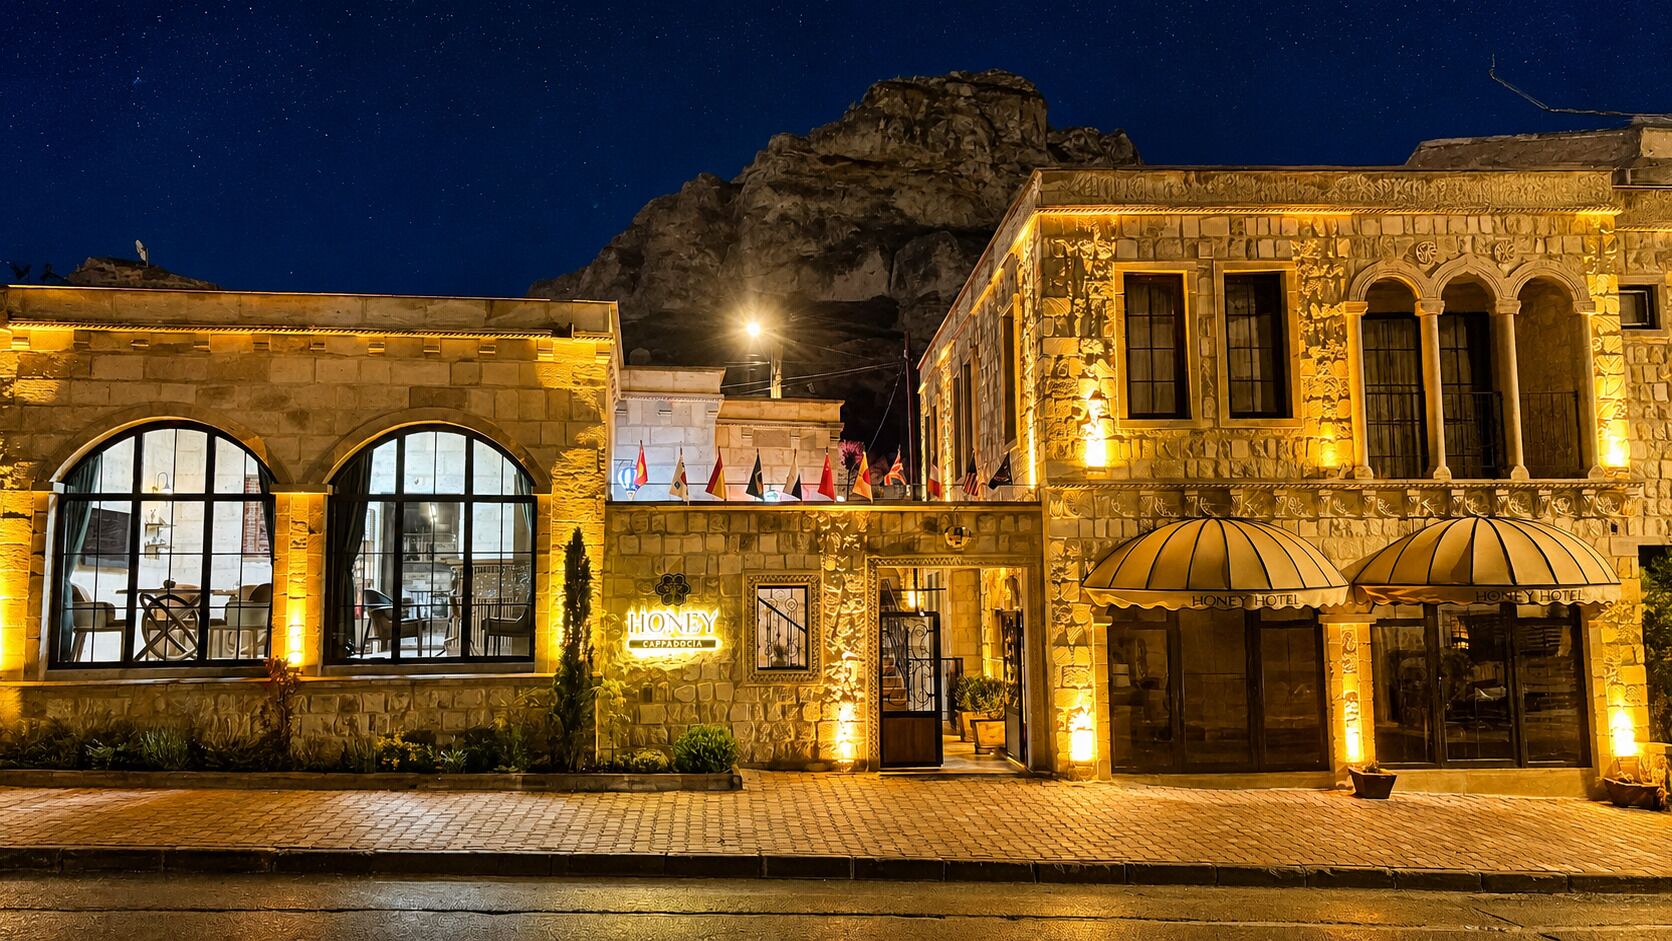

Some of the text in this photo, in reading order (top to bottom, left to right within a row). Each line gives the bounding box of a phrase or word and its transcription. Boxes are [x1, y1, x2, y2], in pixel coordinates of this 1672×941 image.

[1192, 594, 1299, 607] HONEY HOTEL
[1475, 590, 1585, 602] HONEY HOTEL
[629, 611, 717, 633] HONEY
[642, 640, 703, 648] CAPPADOCIA
